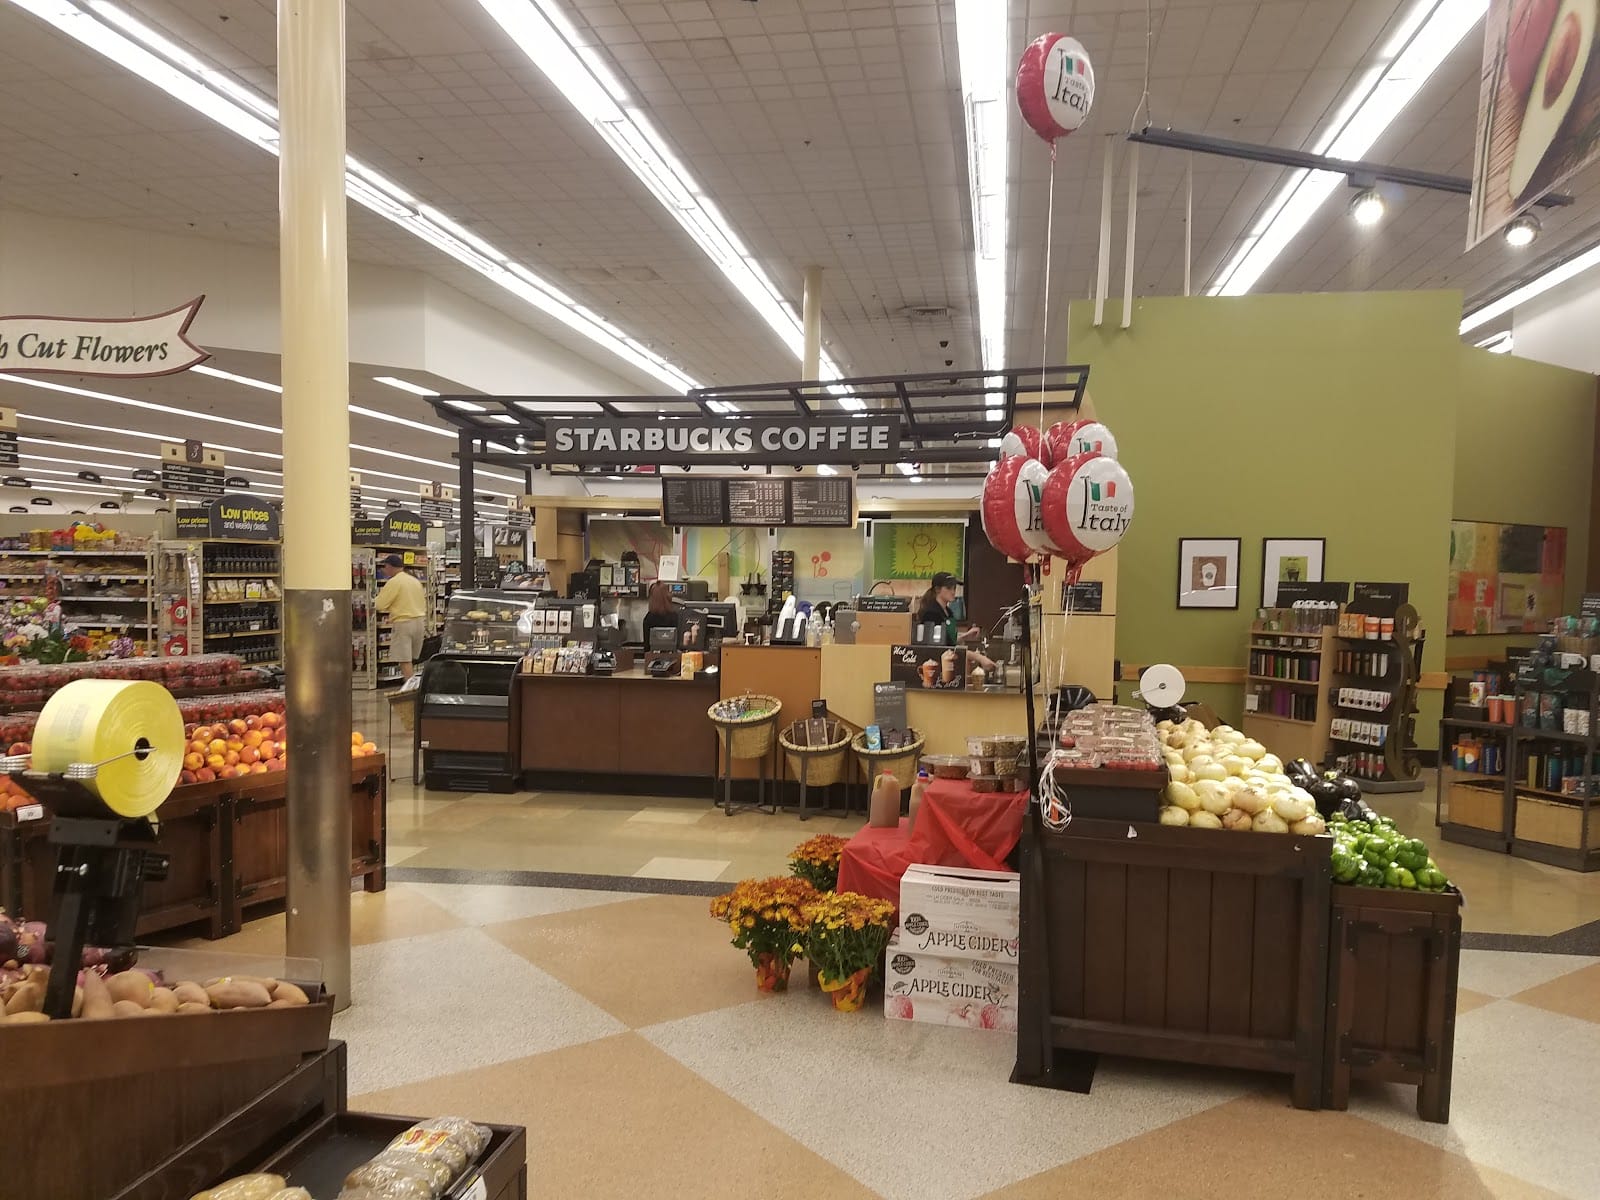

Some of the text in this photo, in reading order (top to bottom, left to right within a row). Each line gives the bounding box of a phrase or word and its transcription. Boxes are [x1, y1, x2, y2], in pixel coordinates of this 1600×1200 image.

[17, 333, 68, 358] Cut
[72, 335, 169, 363] Flowers
[555, 425, 890, 452] STARBUCKS COFFEE
[191, 444, 199, 458] 3
[1077, 476, 1130, 536] Italy
[1091, 504, 1127, 512] Taste of
[220, 505, 269, 522] Low prices
[191, 517, 208, 525] prices
[224, 520, 234, 529] and
[235, 522, 252, 531] weekly
[390, 518, 421, 532] Low prices
[893, 646, 906, 655] Hot
[902, 654, 917, 663] Cold
[918, 932, 1017, 957] APPLE CIDER
[902, 978, 1000, 1005] APPLE CIDER
